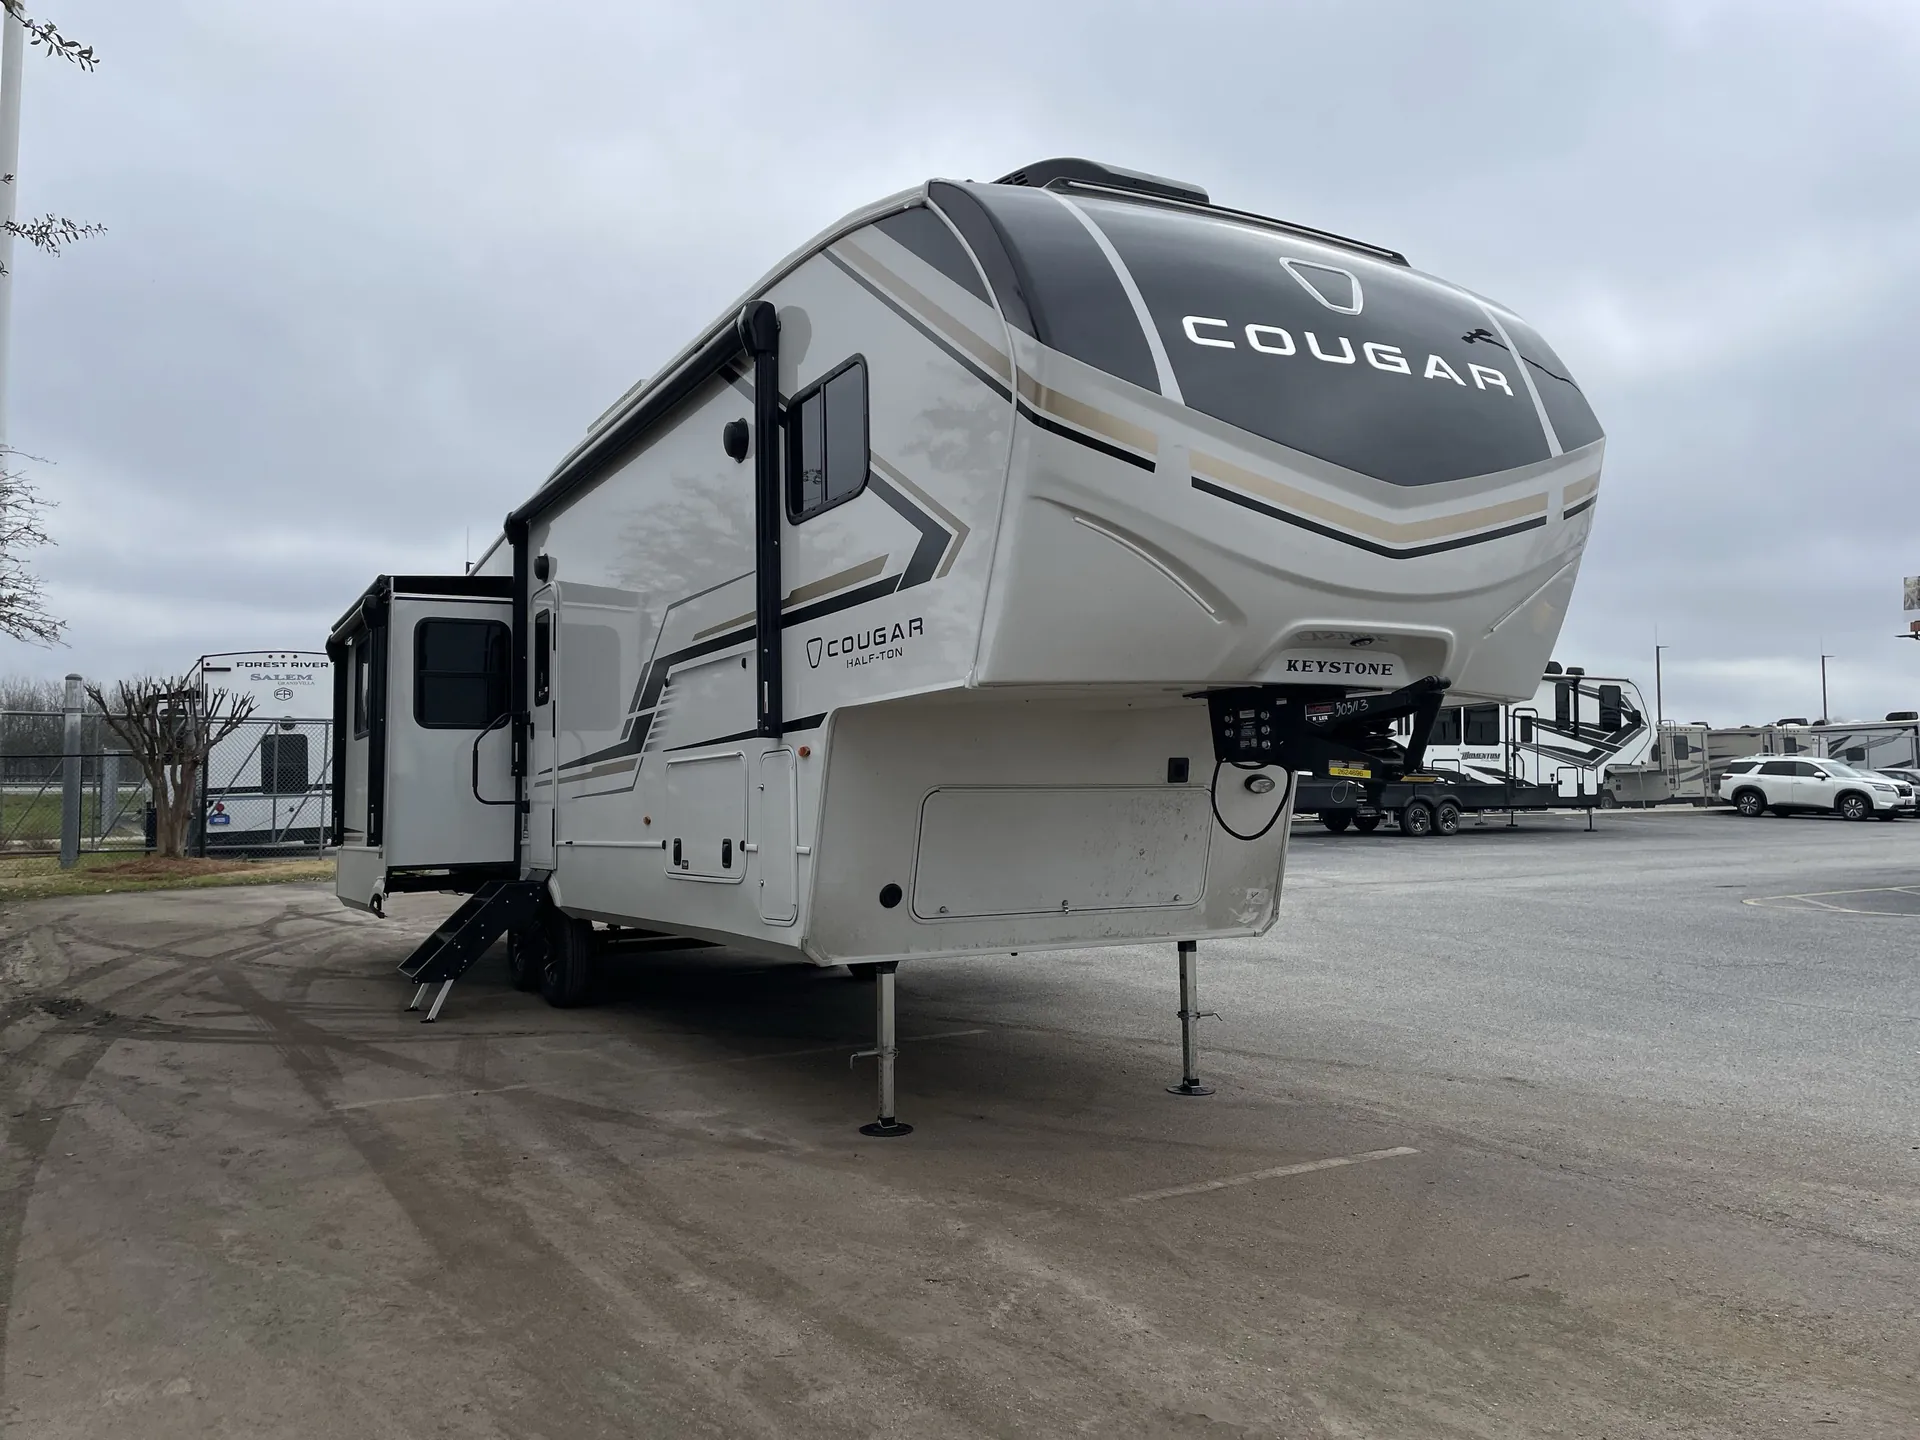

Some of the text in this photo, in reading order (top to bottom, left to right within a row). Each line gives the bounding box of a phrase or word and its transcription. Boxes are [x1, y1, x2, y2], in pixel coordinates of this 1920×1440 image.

[1182, 315, 1514, 397] COUGAR
[827, 617, 923, 657] COUGAR
[846, 647, 903, 668] HALF-TON
[1286, 659, 1394, 676] KEYSTONE
[250, 673, 313, 681] SALEM
